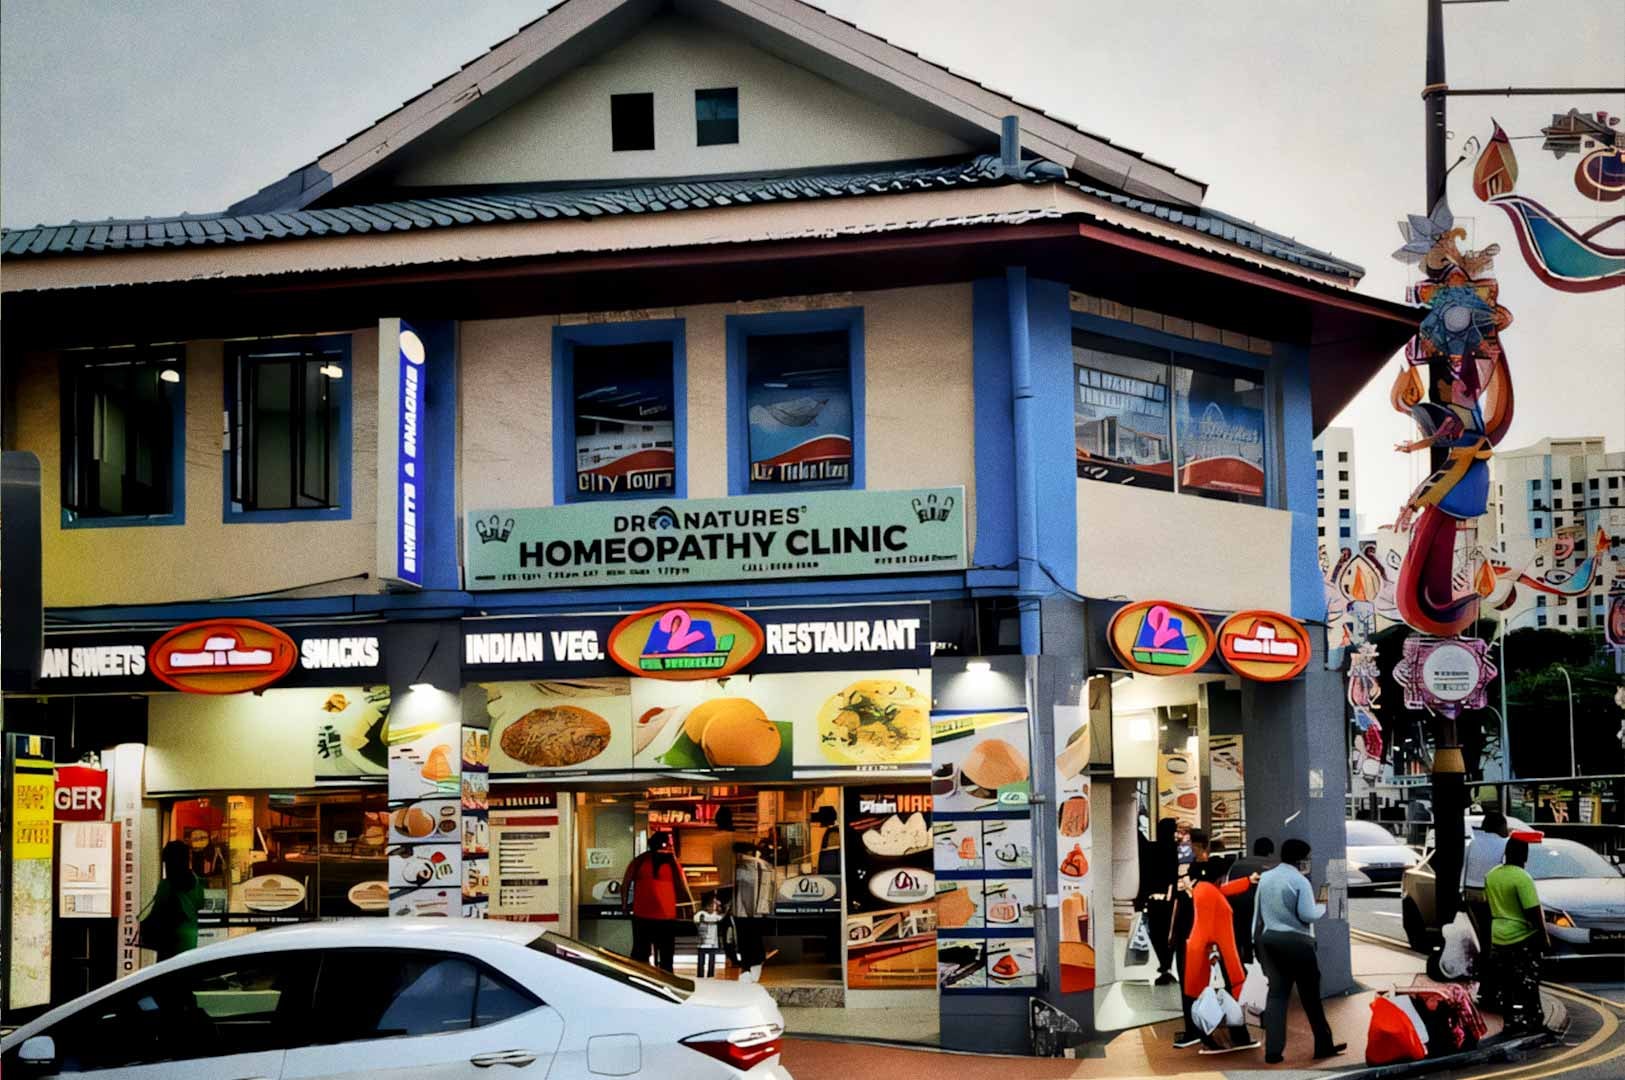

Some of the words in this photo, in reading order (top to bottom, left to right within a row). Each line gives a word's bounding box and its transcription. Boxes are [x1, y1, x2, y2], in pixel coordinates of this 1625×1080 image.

[519, 530, 777, 568] HOMEOPATHY
[785, 525, 908, 556] CLINIC
[300, 636, 379, 669] SNACKS
[465, 632, 544, 664] INDIAN
[550, 630, 605, 661] VEG.
[766, 618, 920, 655] RESTAURANT
[71, 645, 146, 677] SWEETS
[54, 785, 102, 810] GER
